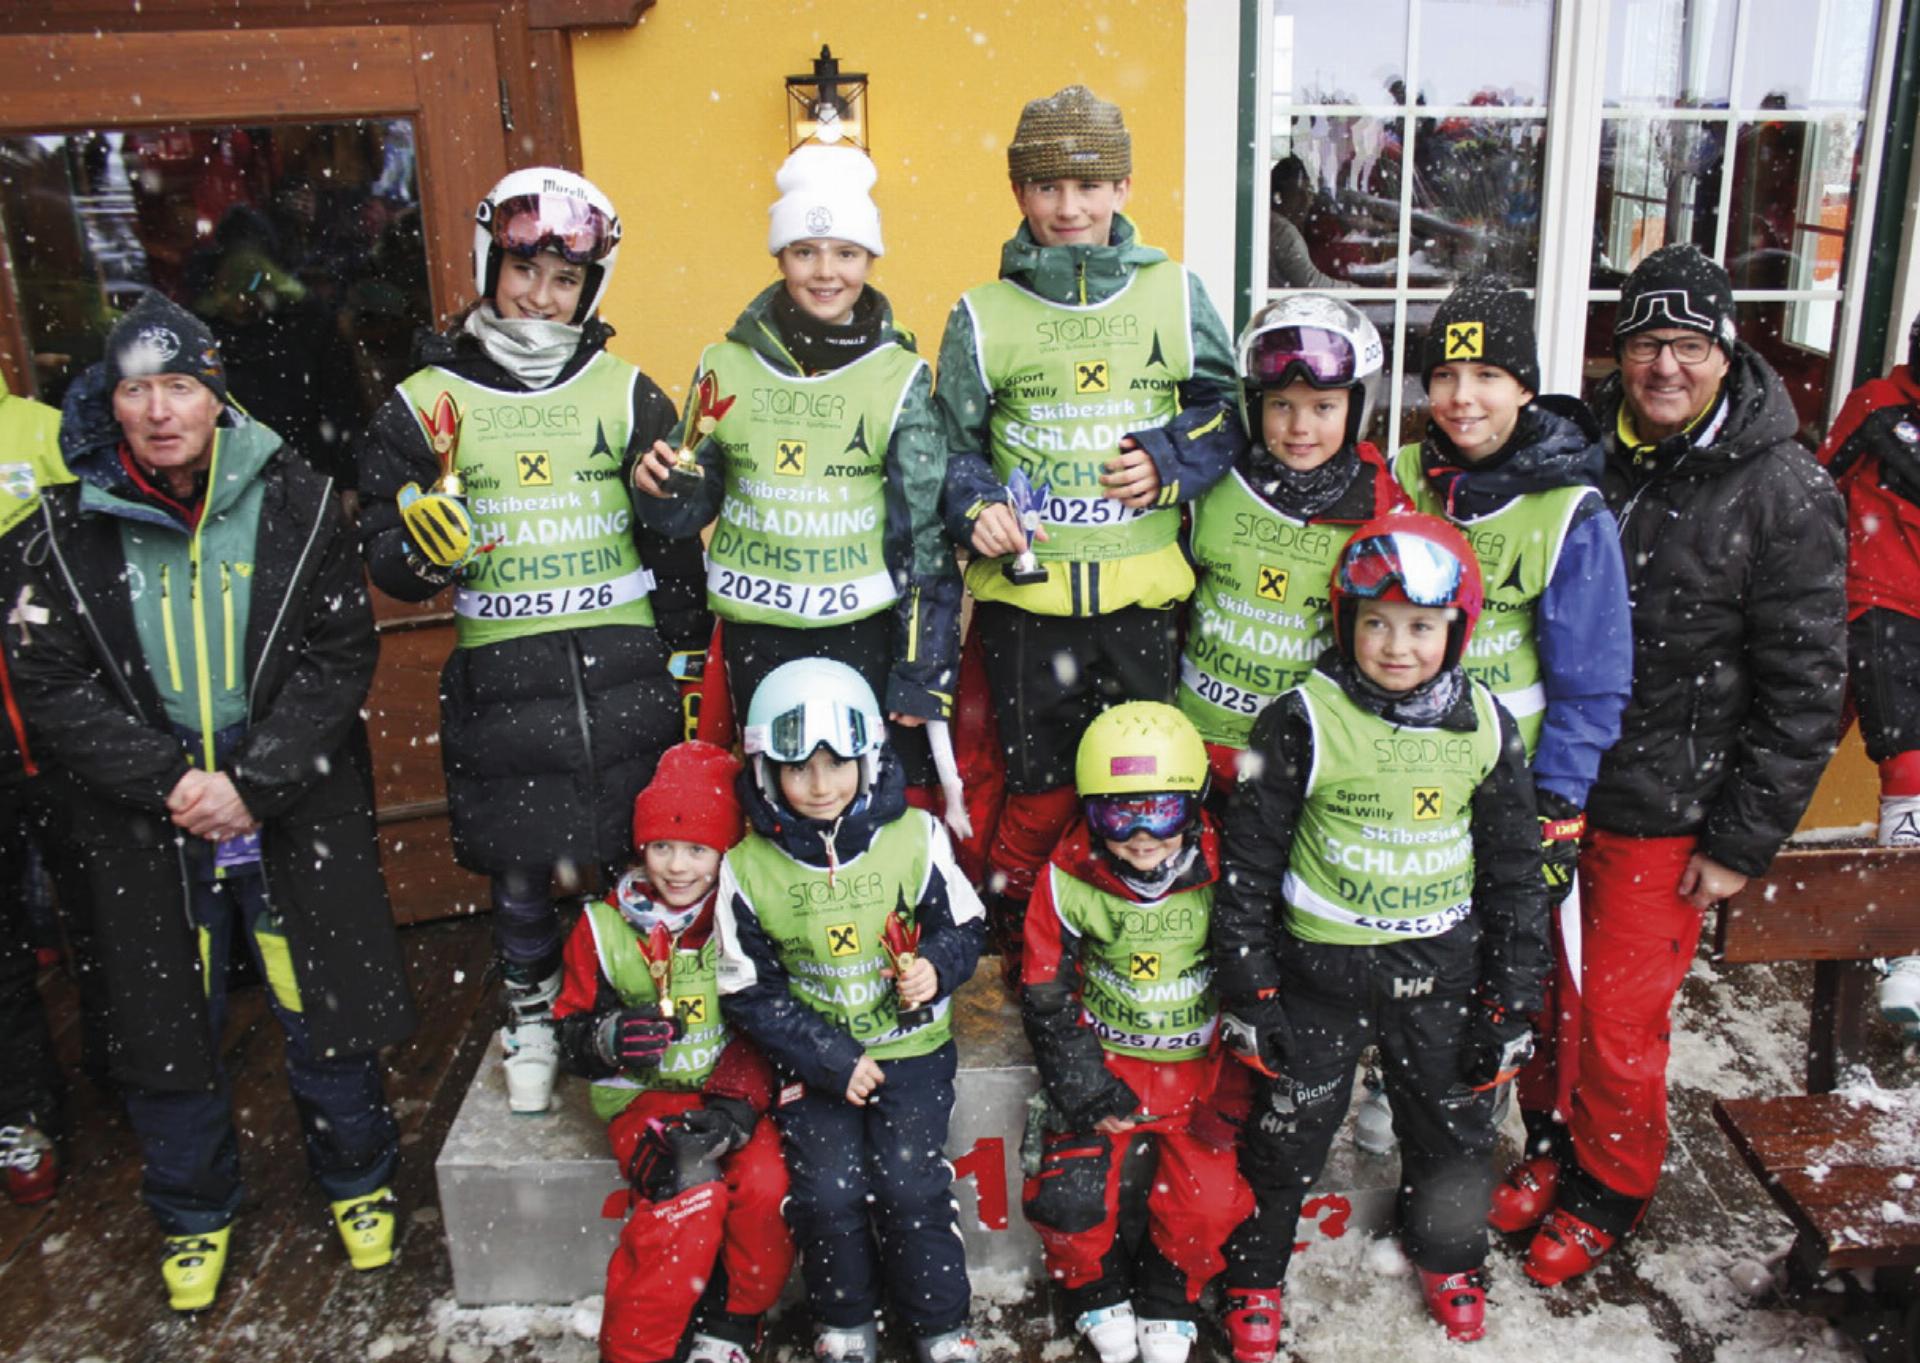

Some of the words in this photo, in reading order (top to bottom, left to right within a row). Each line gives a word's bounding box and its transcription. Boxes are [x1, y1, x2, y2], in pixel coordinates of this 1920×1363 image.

[1030, 399, 1136, 421] Skibezirk
[475, 492, 582, 516] Skibezirk
[590, 490, 601, 505] 1
[738, 476, 831, 504] Skibezirk
[839, 486, 849, 501] 1
[472, 509, 629, 547] HLADMING
[721, 495, 876, 538] SCHLADMING
[717, 531, 869, 573] DACHSTEIN
[477, 591, 554, 618] 2025
[578, 584, 613, 612] 26
[719, 571, 793, 609] 2025
[818, 583, 859, 616] 26
[1216, 592, 1306, 631] Skibezirk
[1195, 636, 1309, 691] DACHSTE
[1197, 672, 1258, 714] 2025
[1336, 789, 1380, 803] Sport
[1355, 805, 1394, 821] Willy
[1339, 871, 1472, 914] DACHSTE
[798, 956, 886, 979] Skibezirk
[954, 1136, 1008, 1231] 1
